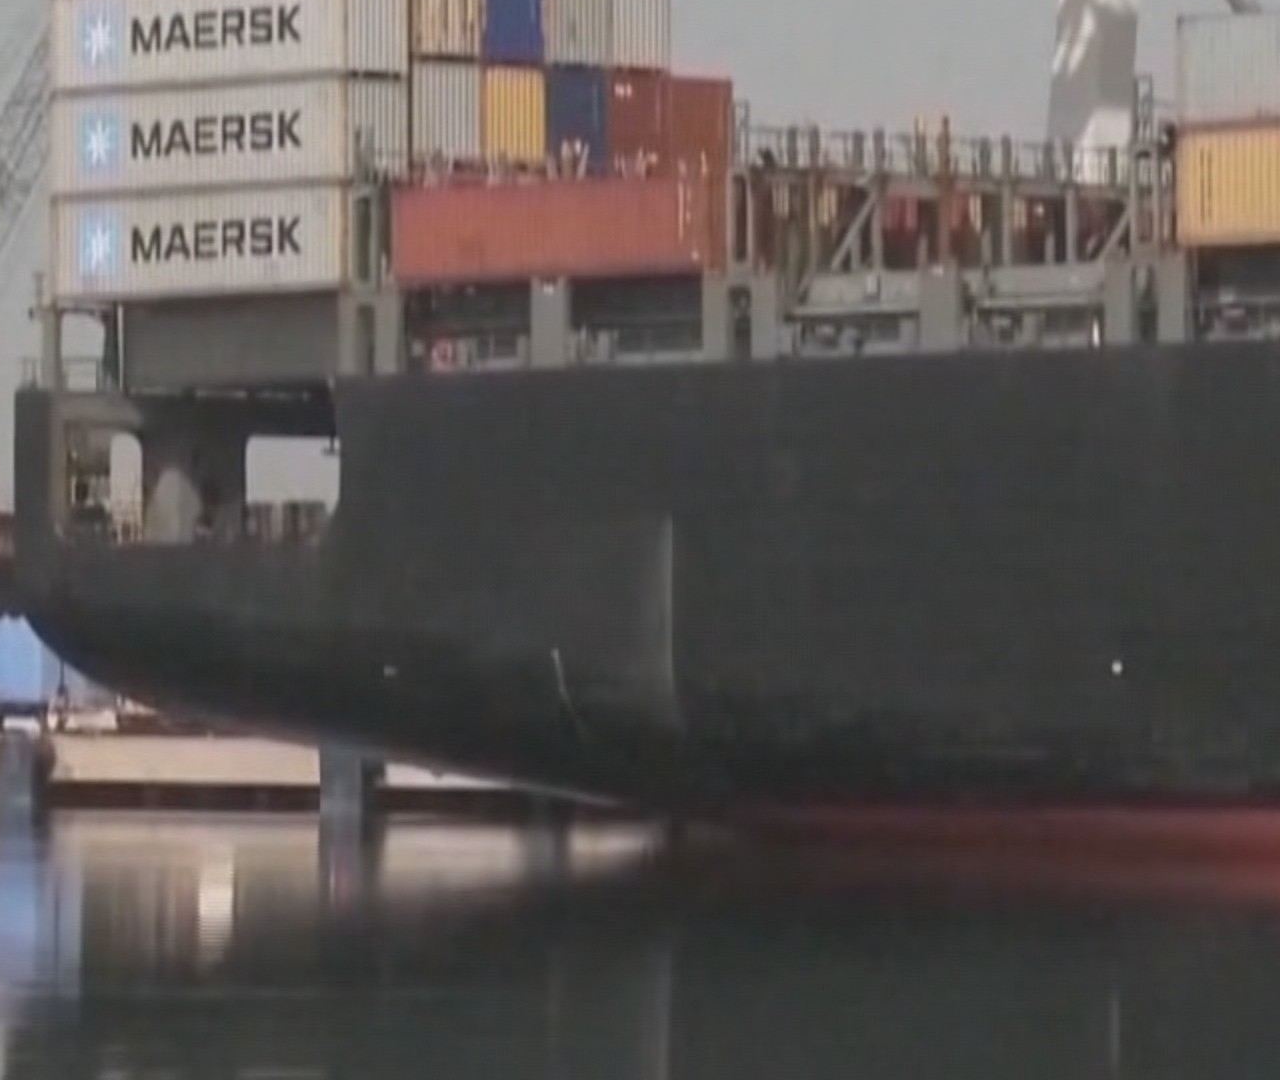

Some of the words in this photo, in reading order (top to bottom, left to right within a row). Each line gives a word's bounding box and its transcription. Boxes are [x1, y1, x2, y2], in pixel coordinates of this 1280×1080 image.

[131, 4, 301, 55] MAERSK
[131, 109, 301, 159] MAERSK
[131, 216, 301, 263] MAERSK
